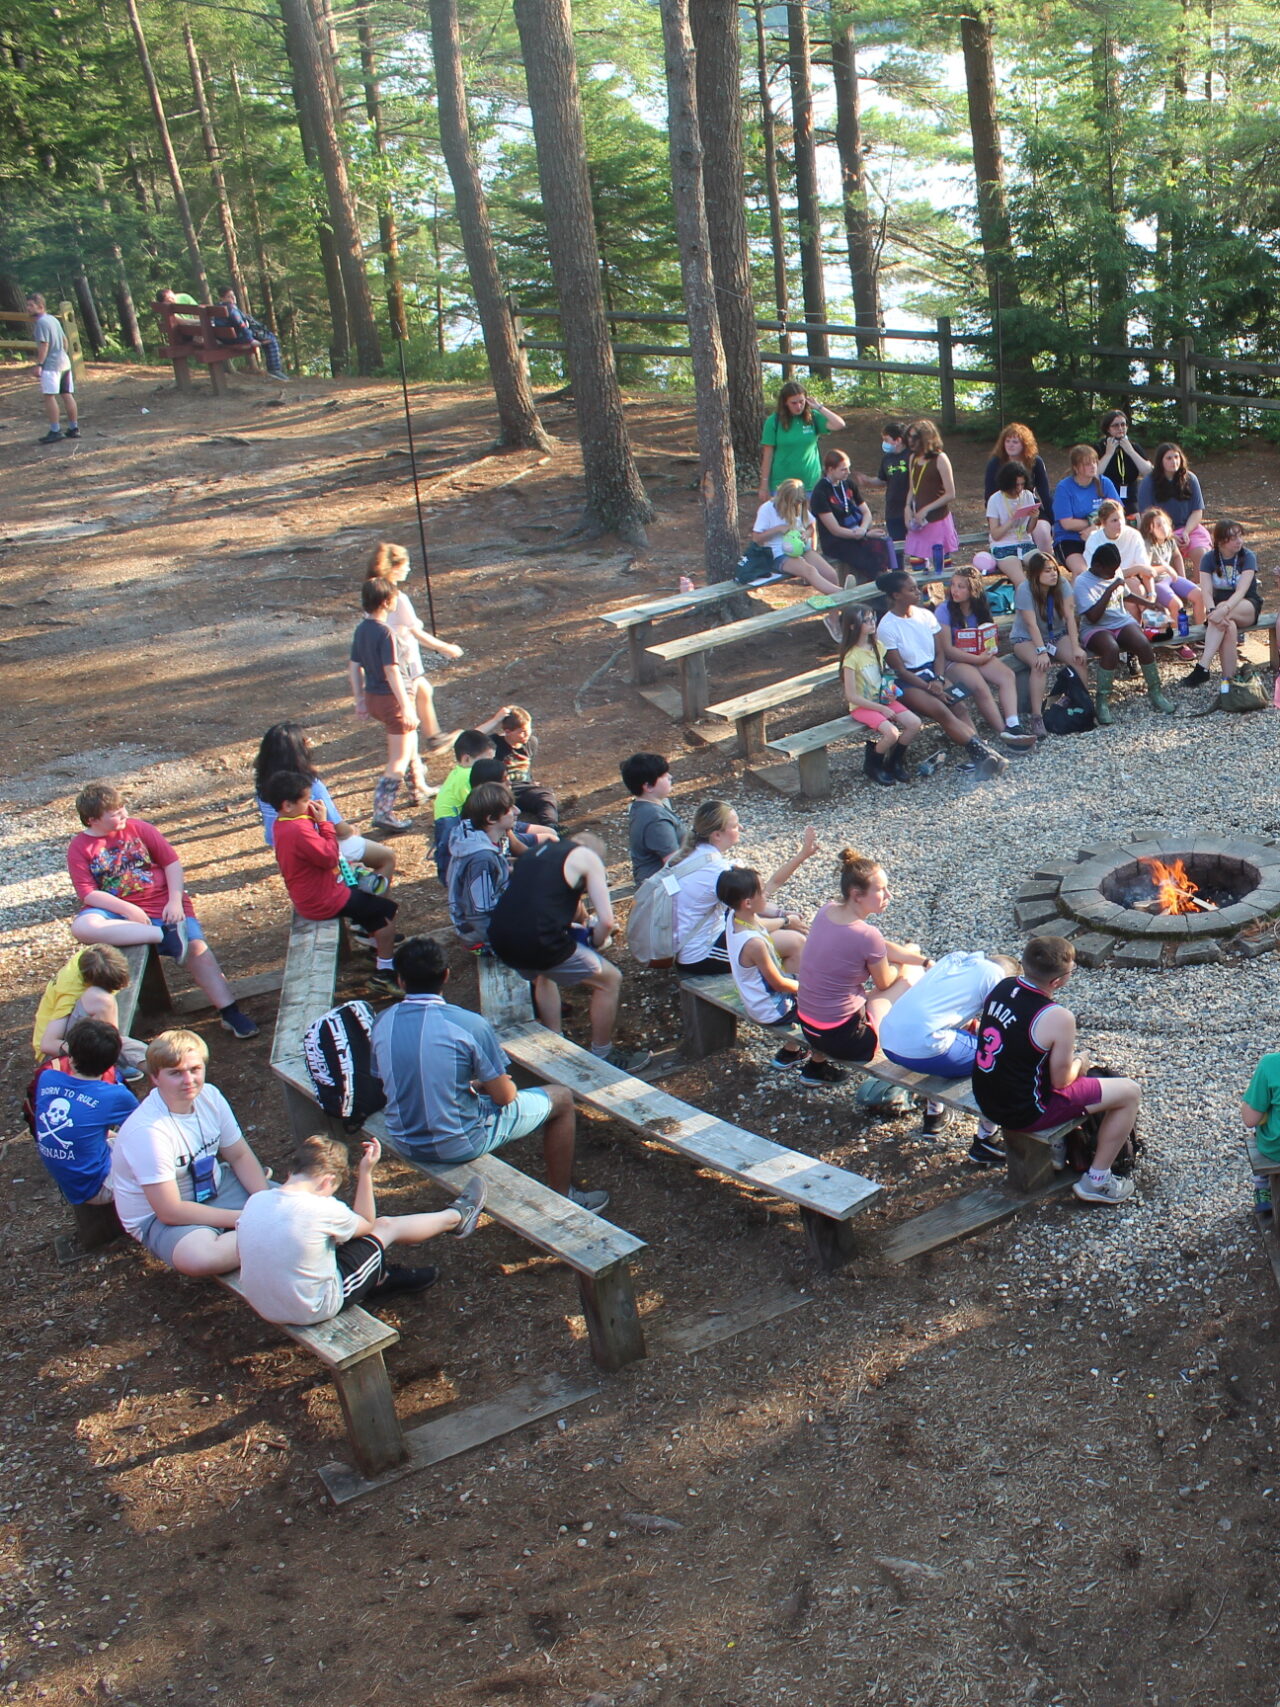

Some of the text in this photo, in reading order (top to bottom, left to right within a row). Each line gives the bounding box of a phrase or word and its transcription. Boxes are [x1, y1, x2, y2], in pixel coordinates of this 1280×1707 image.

[987, 1001, 1017, 1029] WADE
[976, 1027, 1003, 1073] 3
[41, 1086, 99, 1108] BORN TO RULE
